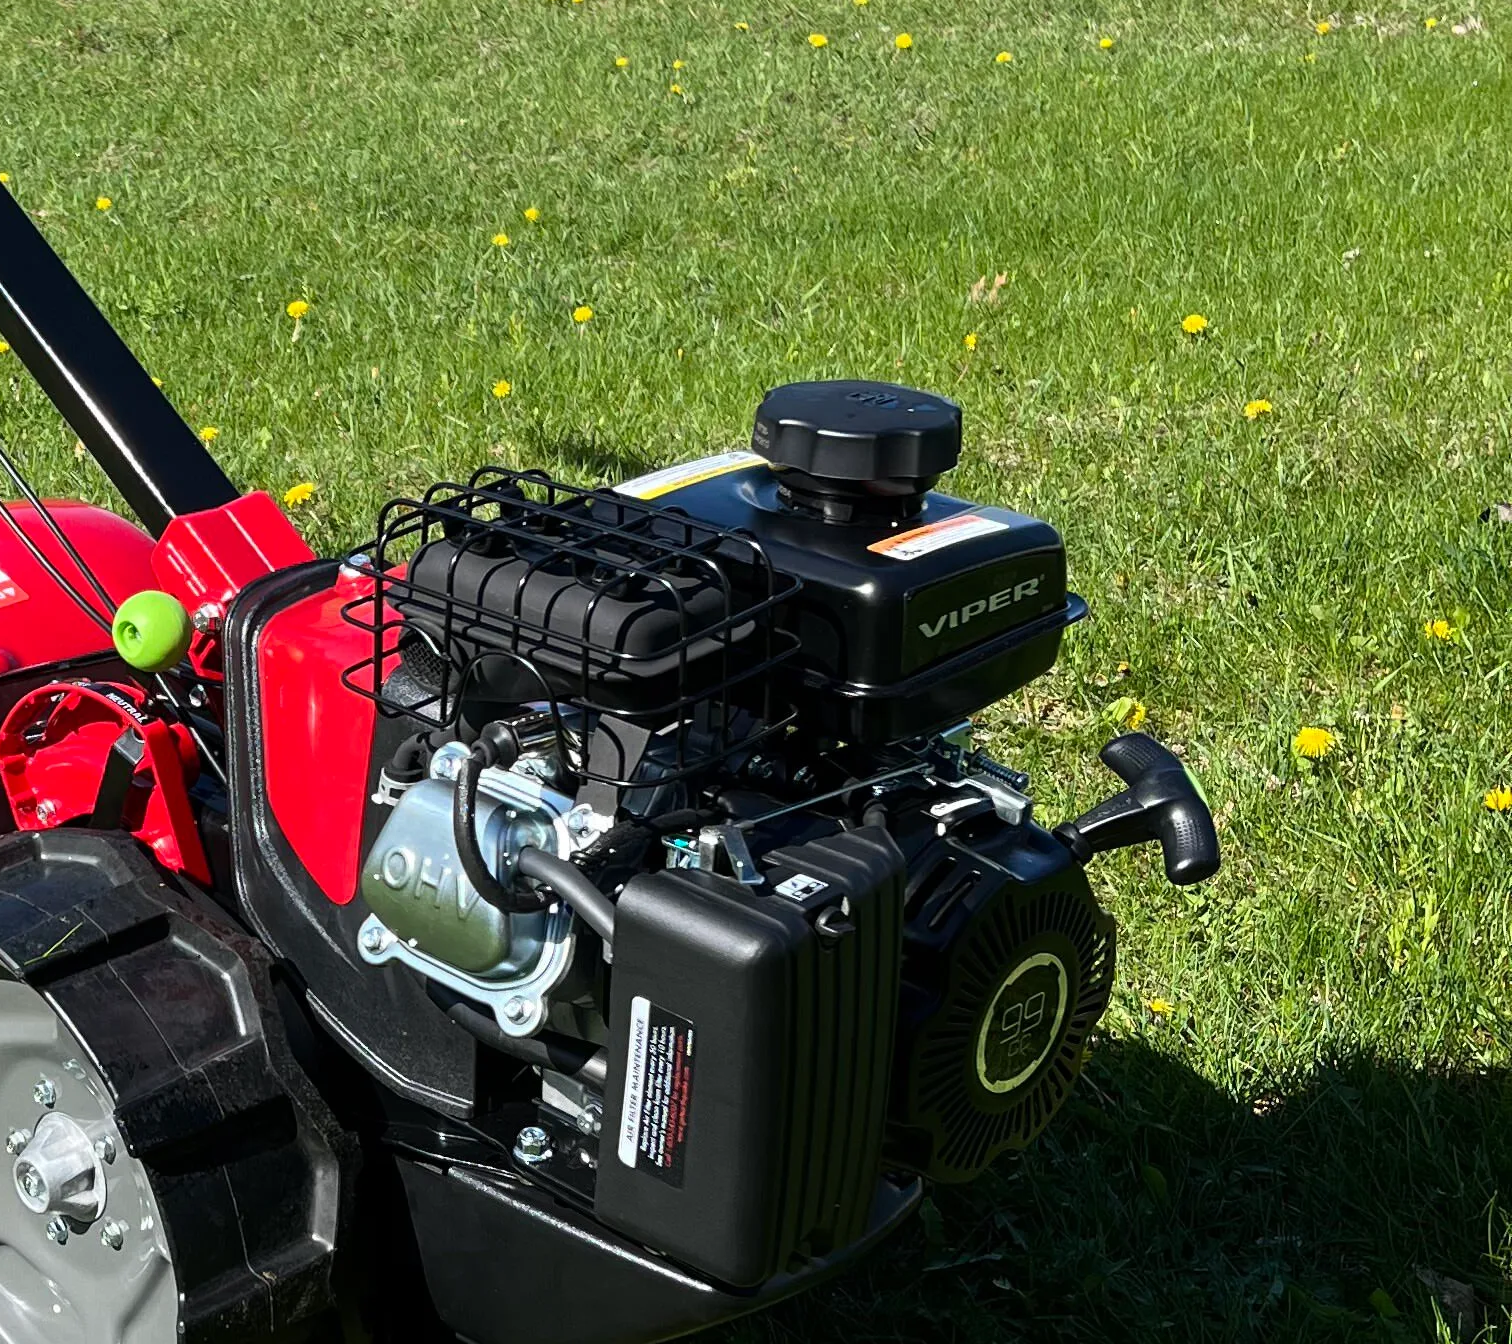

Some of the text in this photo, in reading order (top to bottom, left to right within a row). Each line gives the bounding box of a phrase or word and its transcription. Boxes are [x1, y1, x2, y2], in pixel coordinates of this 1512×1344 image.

[918, 577, 1040, 639] VIPER
[105, 692, 150, 725] NEUTRAL
[380, 844, 482, 922] OHV
[999, 991, 1046, 1045] 99
[626, 1018, 644, 1142] AIR FILTER MAINTENANCE
